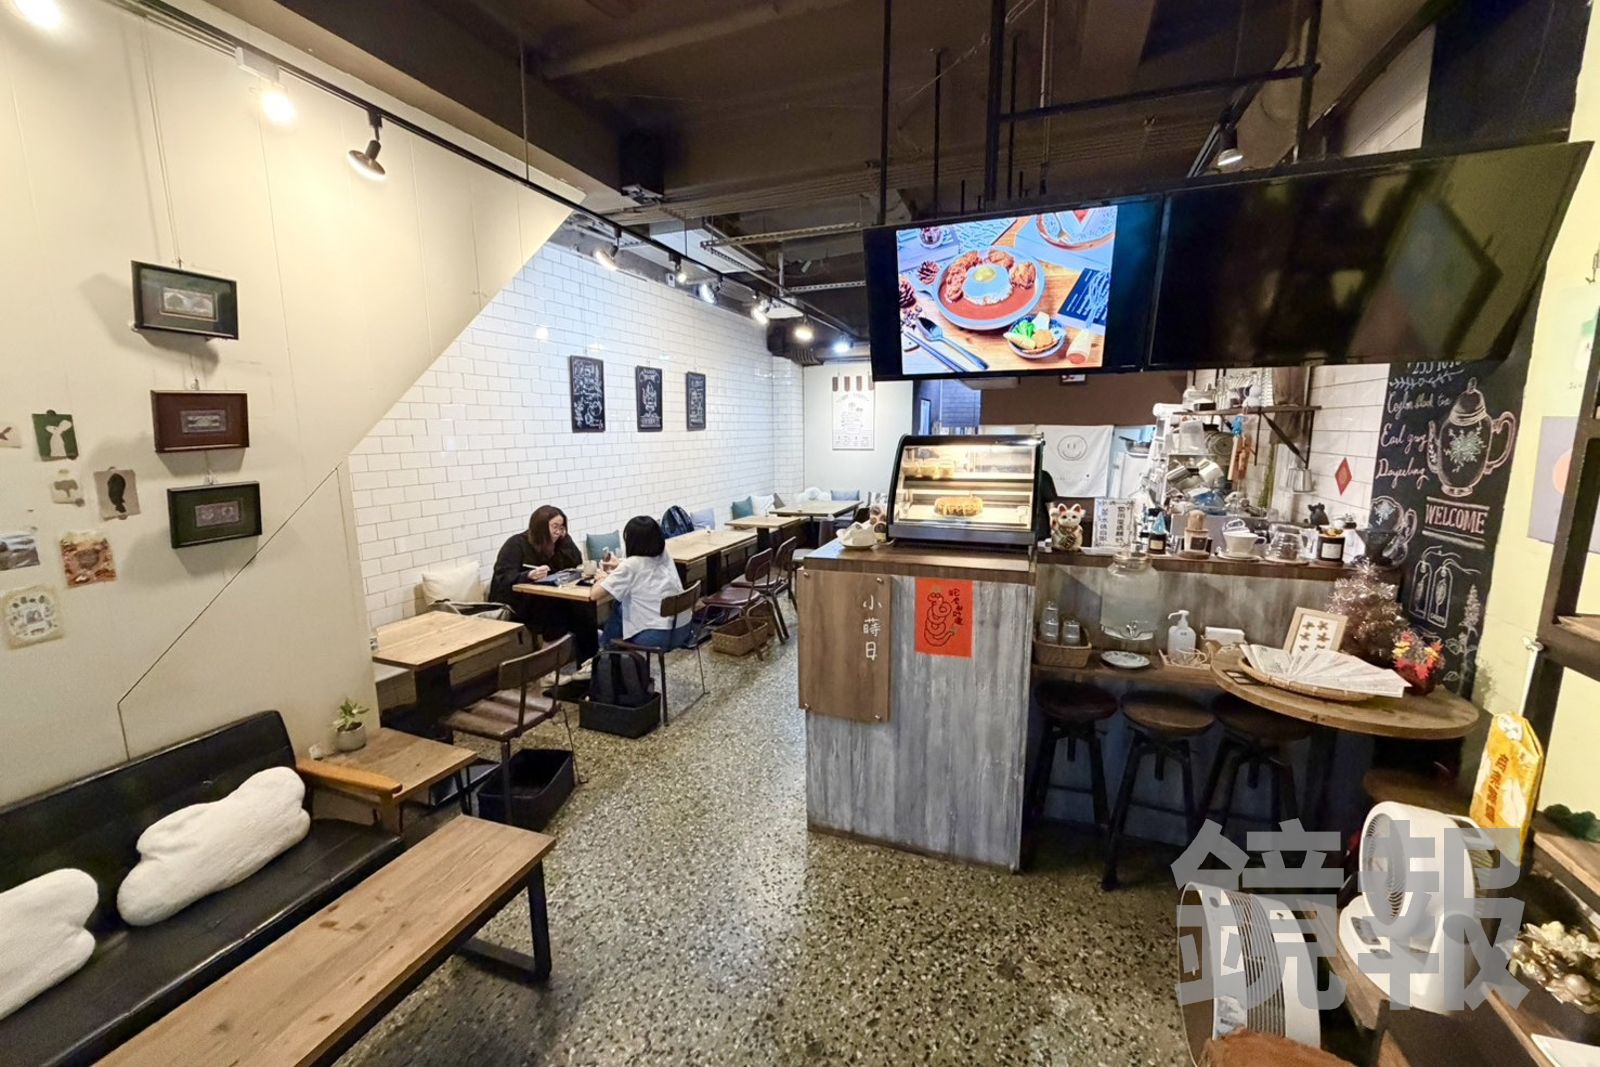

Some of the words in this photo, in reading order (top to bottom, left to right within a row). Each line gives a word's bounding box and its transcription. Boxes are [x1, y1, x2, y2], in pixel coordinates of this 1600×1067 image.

[1425, 504, 1488, 534] WELCOME
[863, 594, 883, 661] 小蒔日
